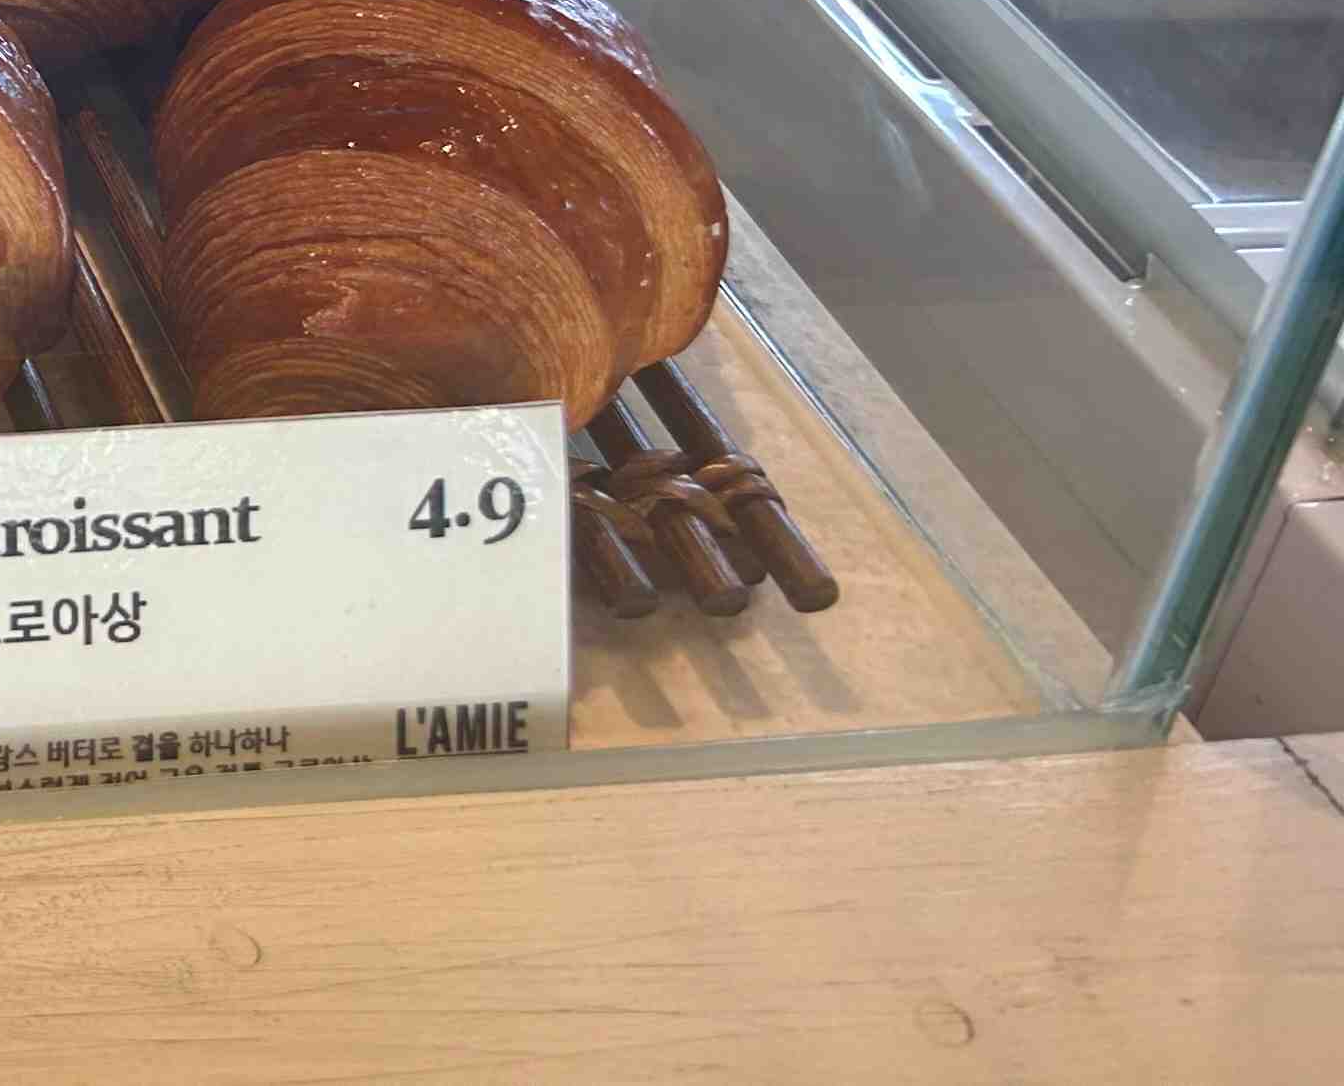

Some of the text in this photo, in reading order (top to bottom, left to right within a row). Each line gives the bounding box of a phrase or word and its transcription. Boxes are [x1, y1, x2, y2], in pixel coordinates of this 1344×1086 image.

[408, 475, 528, 546] 4.9
[47, 736, 125, 768] 버터로
[189, 725, 291, 758] 하나하나
[395, 700, 530, 758] L'AMIE
